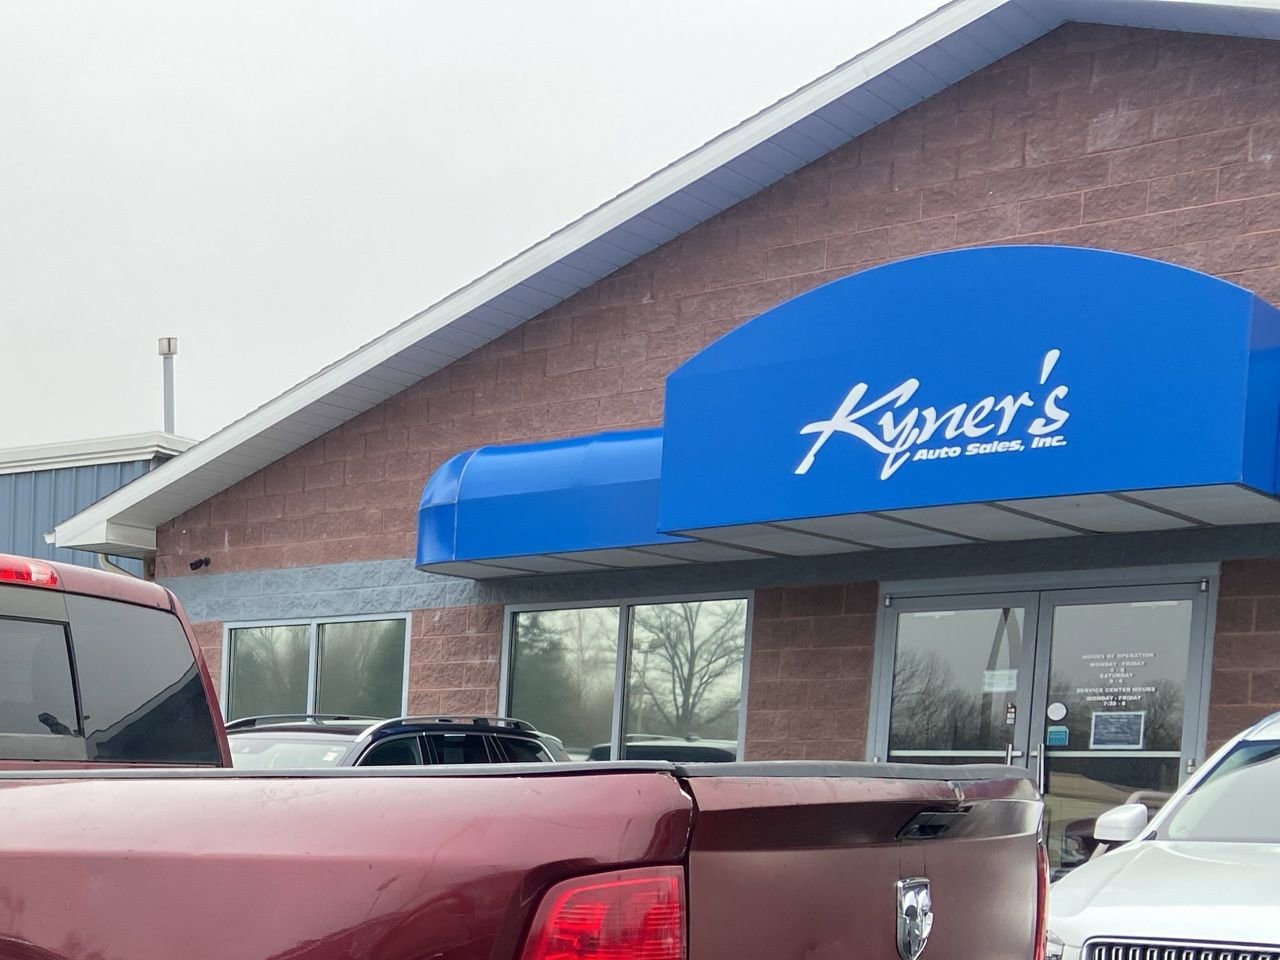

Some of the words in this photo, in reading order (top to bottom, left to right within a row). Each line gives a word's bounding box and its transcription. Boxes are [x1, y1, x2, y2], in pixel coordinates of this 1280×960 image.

[794, 348, 1070, 480] Kyner's
[912, 445, 962, 461] Auto
[965, 438, 1026, 456] Sales,
[1031, 434, 1067, 449] Inc.
